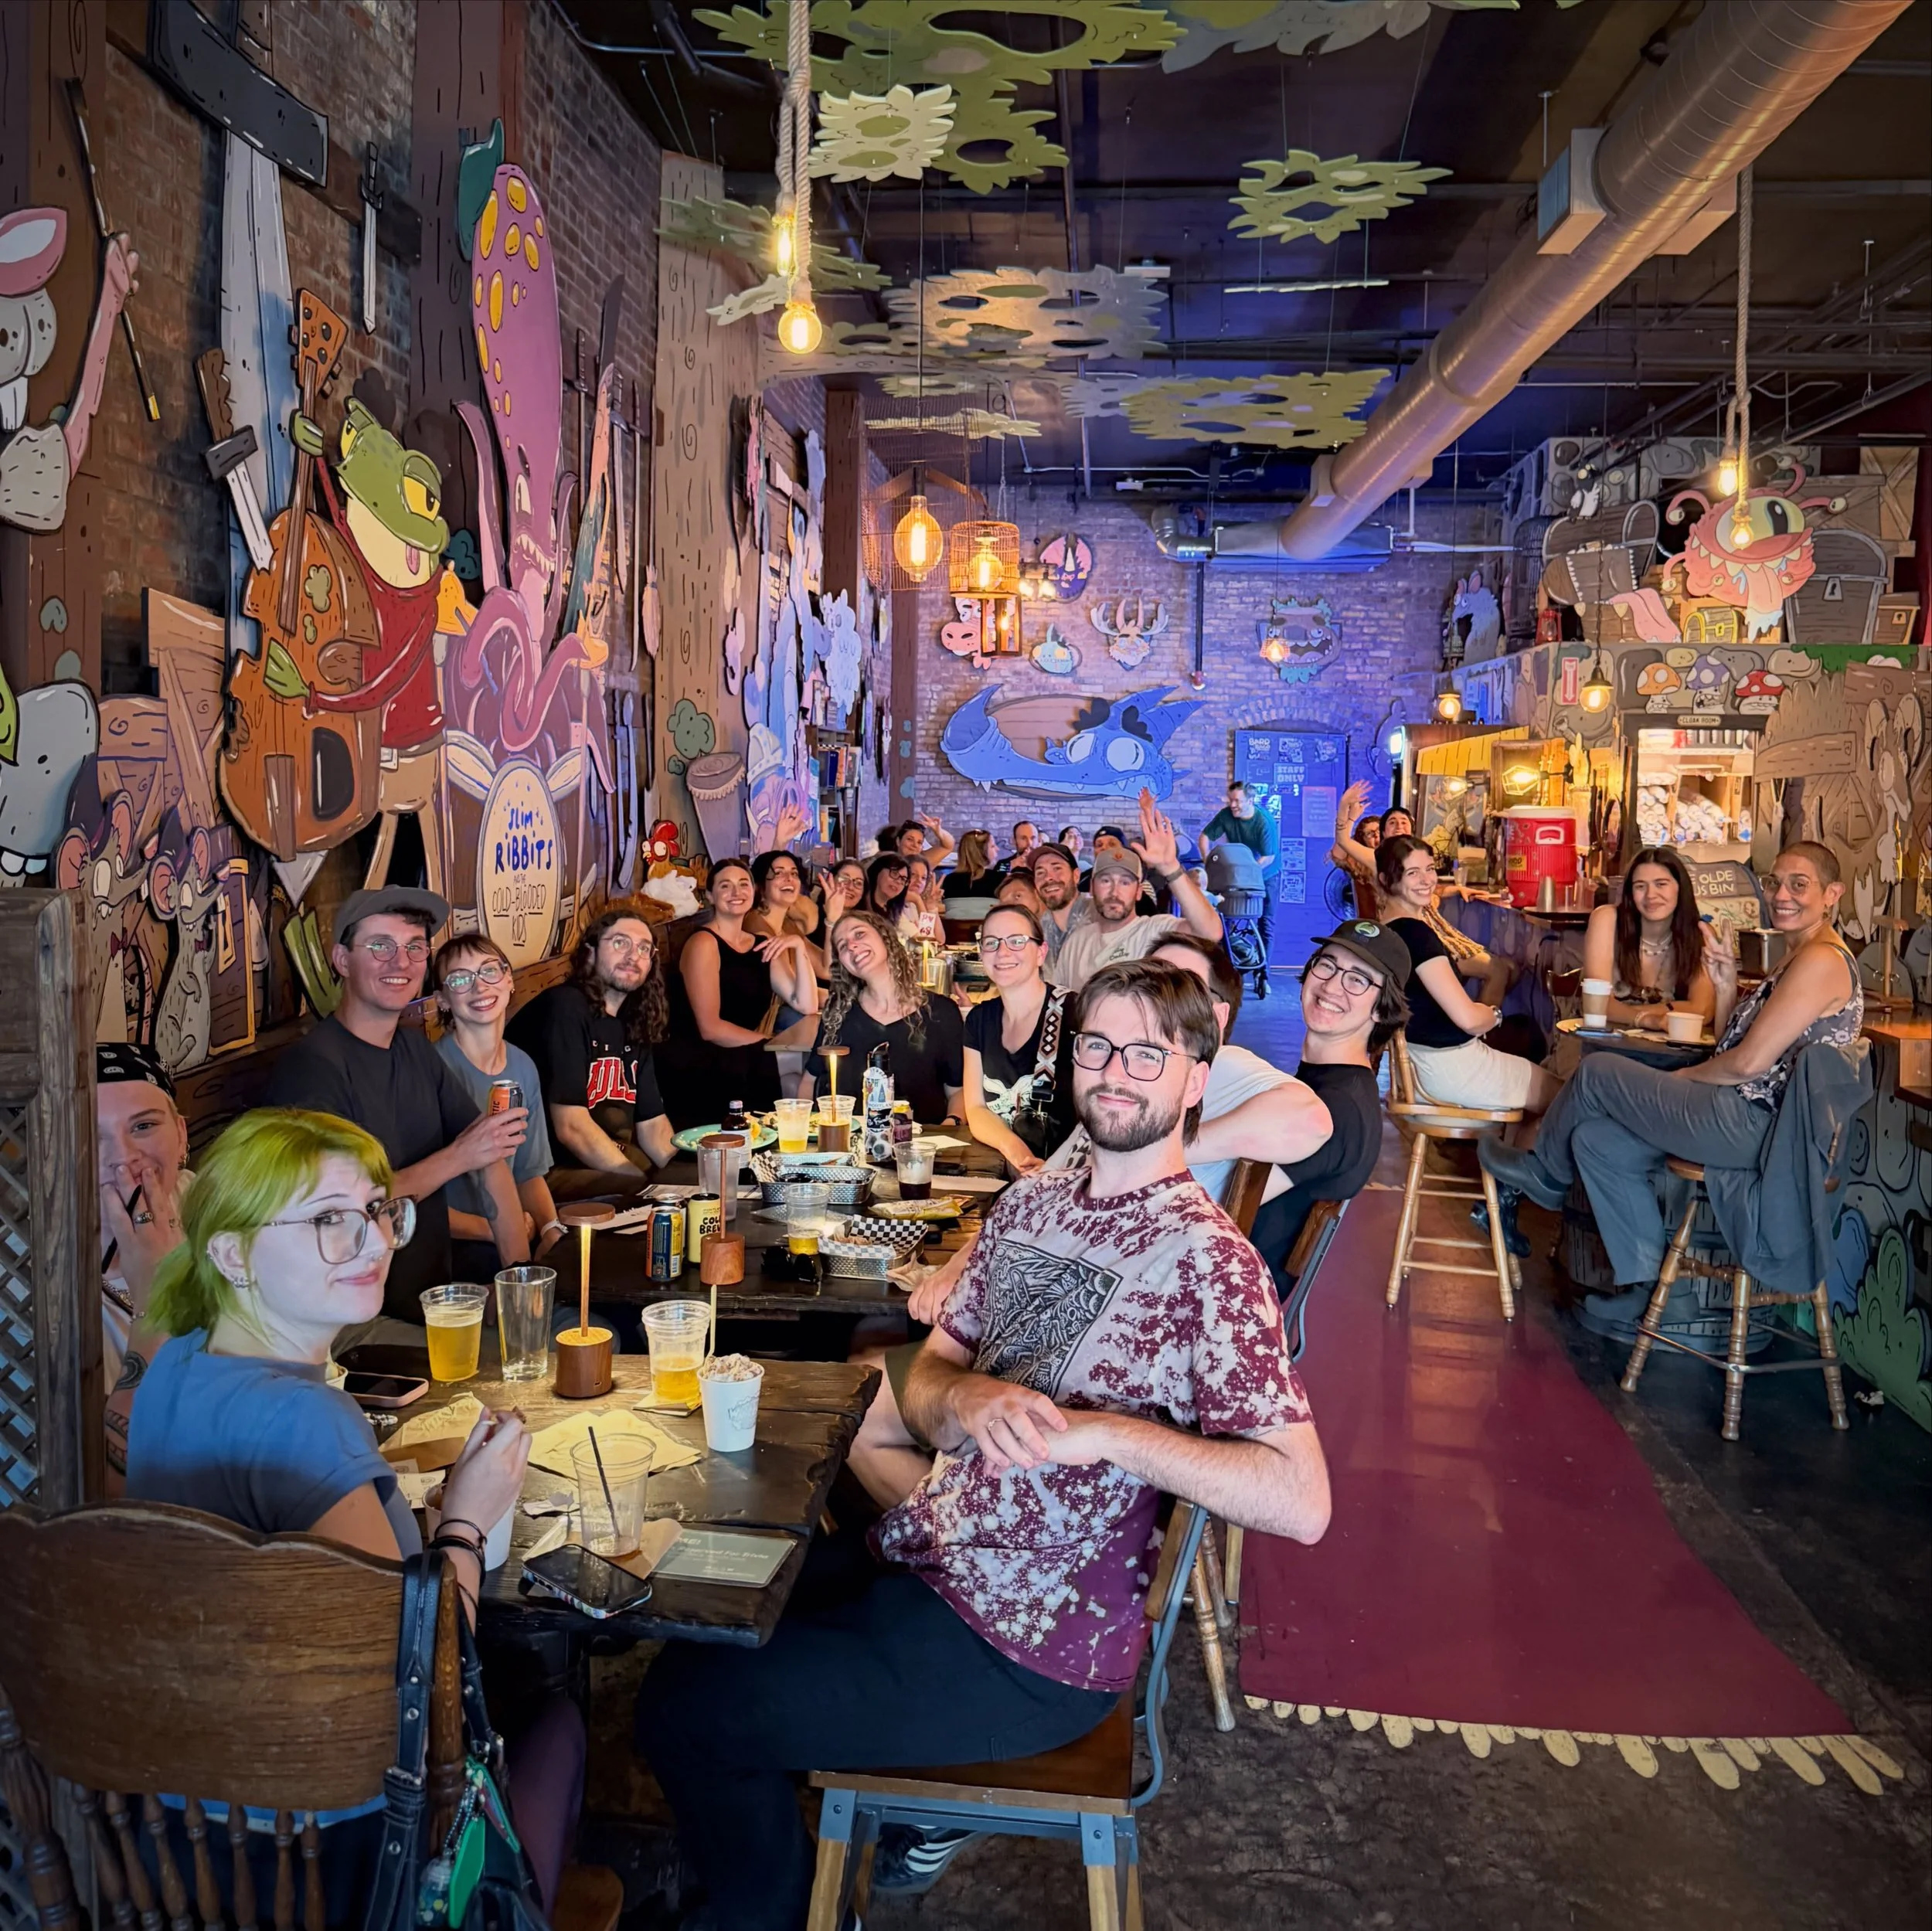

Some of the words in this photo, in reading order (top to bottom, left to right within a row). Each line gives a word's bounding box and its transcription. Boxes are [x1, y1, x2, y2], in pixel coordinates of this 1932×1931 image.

[1277, 774, 1305, 783] ONLY
[1699, 869, 1733, 884] OLDE
[1709, 882, 1734, 896] BIN
[512, 913, 527, 943] KIDS
[702, 1216, 720, 1226] COL
